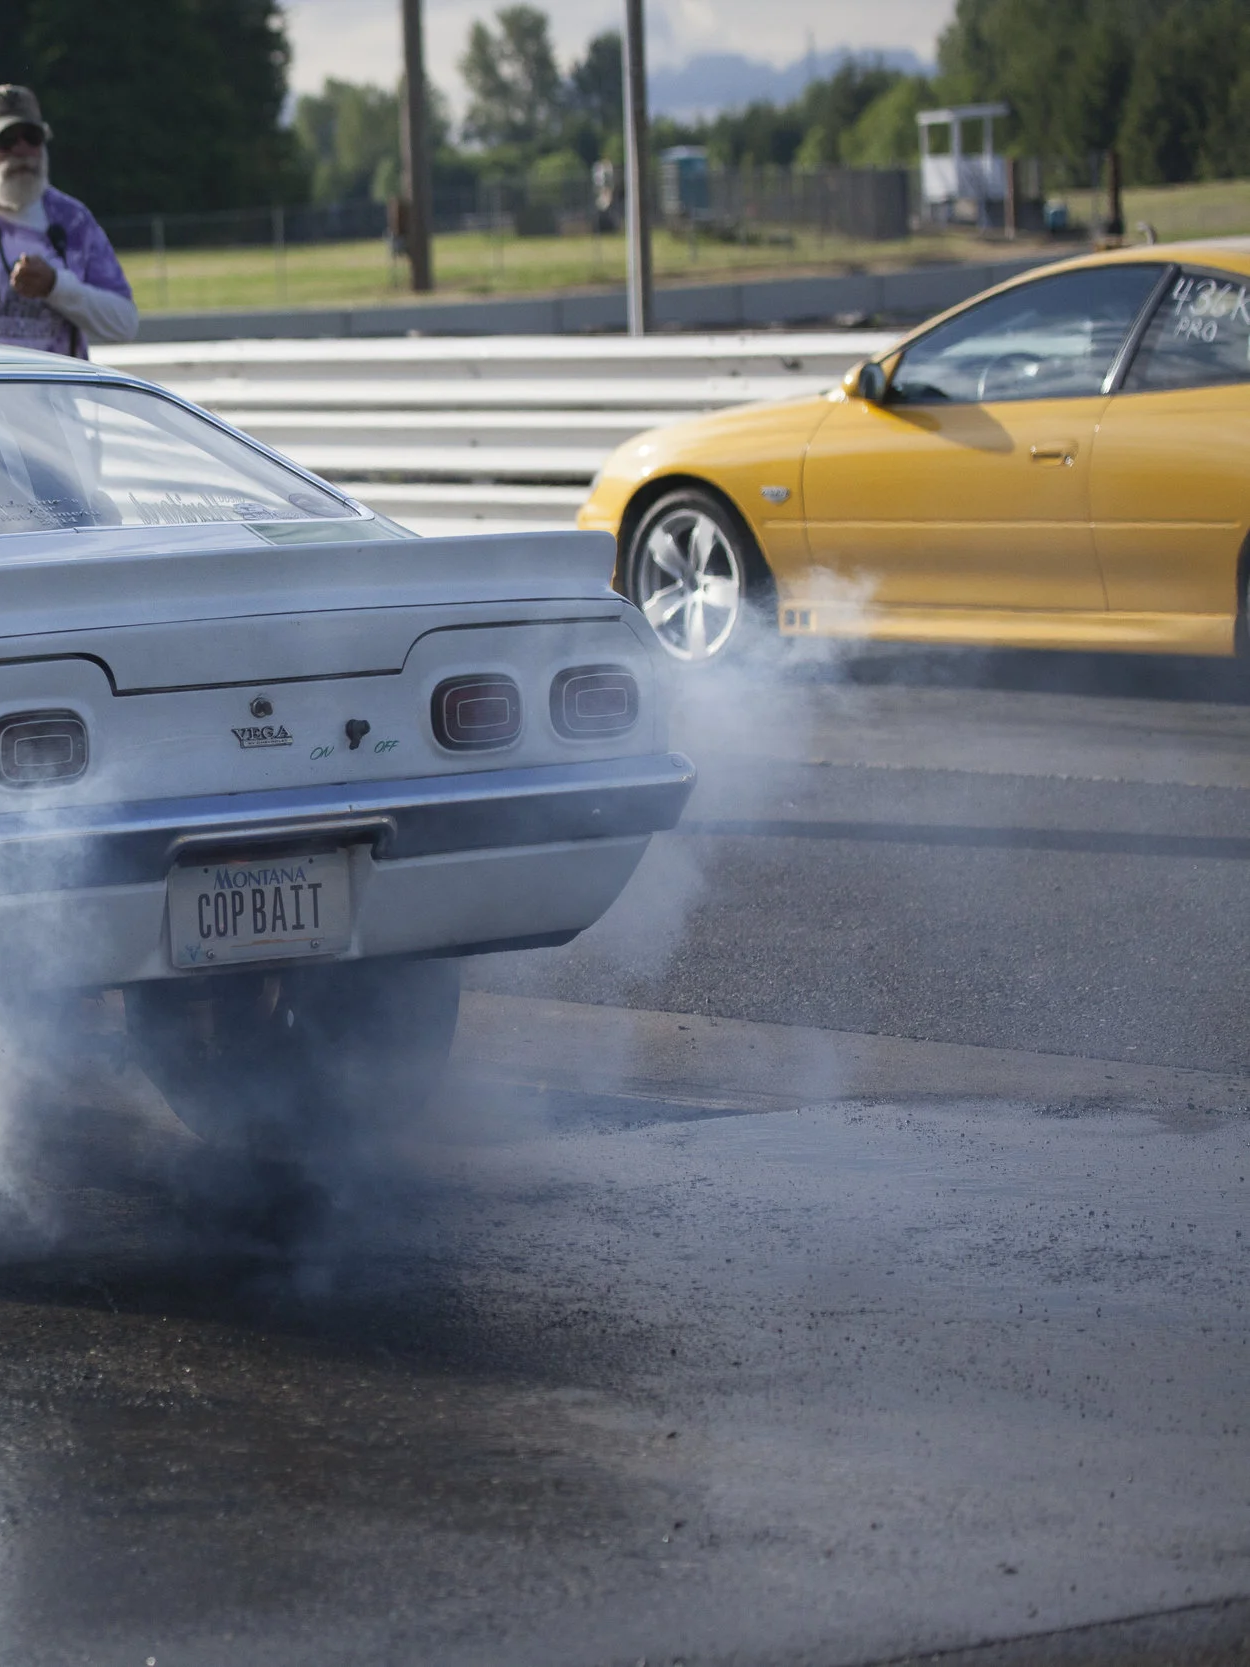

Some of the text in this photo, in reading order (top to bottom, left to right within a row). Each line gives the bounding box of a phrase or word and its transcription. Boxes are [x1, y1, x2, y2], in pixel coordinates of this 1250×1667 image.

[1174, 317, 1218, 342] PRO
[231, 725, 291, 740] VEGA
[310, 746, 335, 760] ON
[374, 740, 400, 753] OFF
[214, 866, 307, 890] MONTANA
